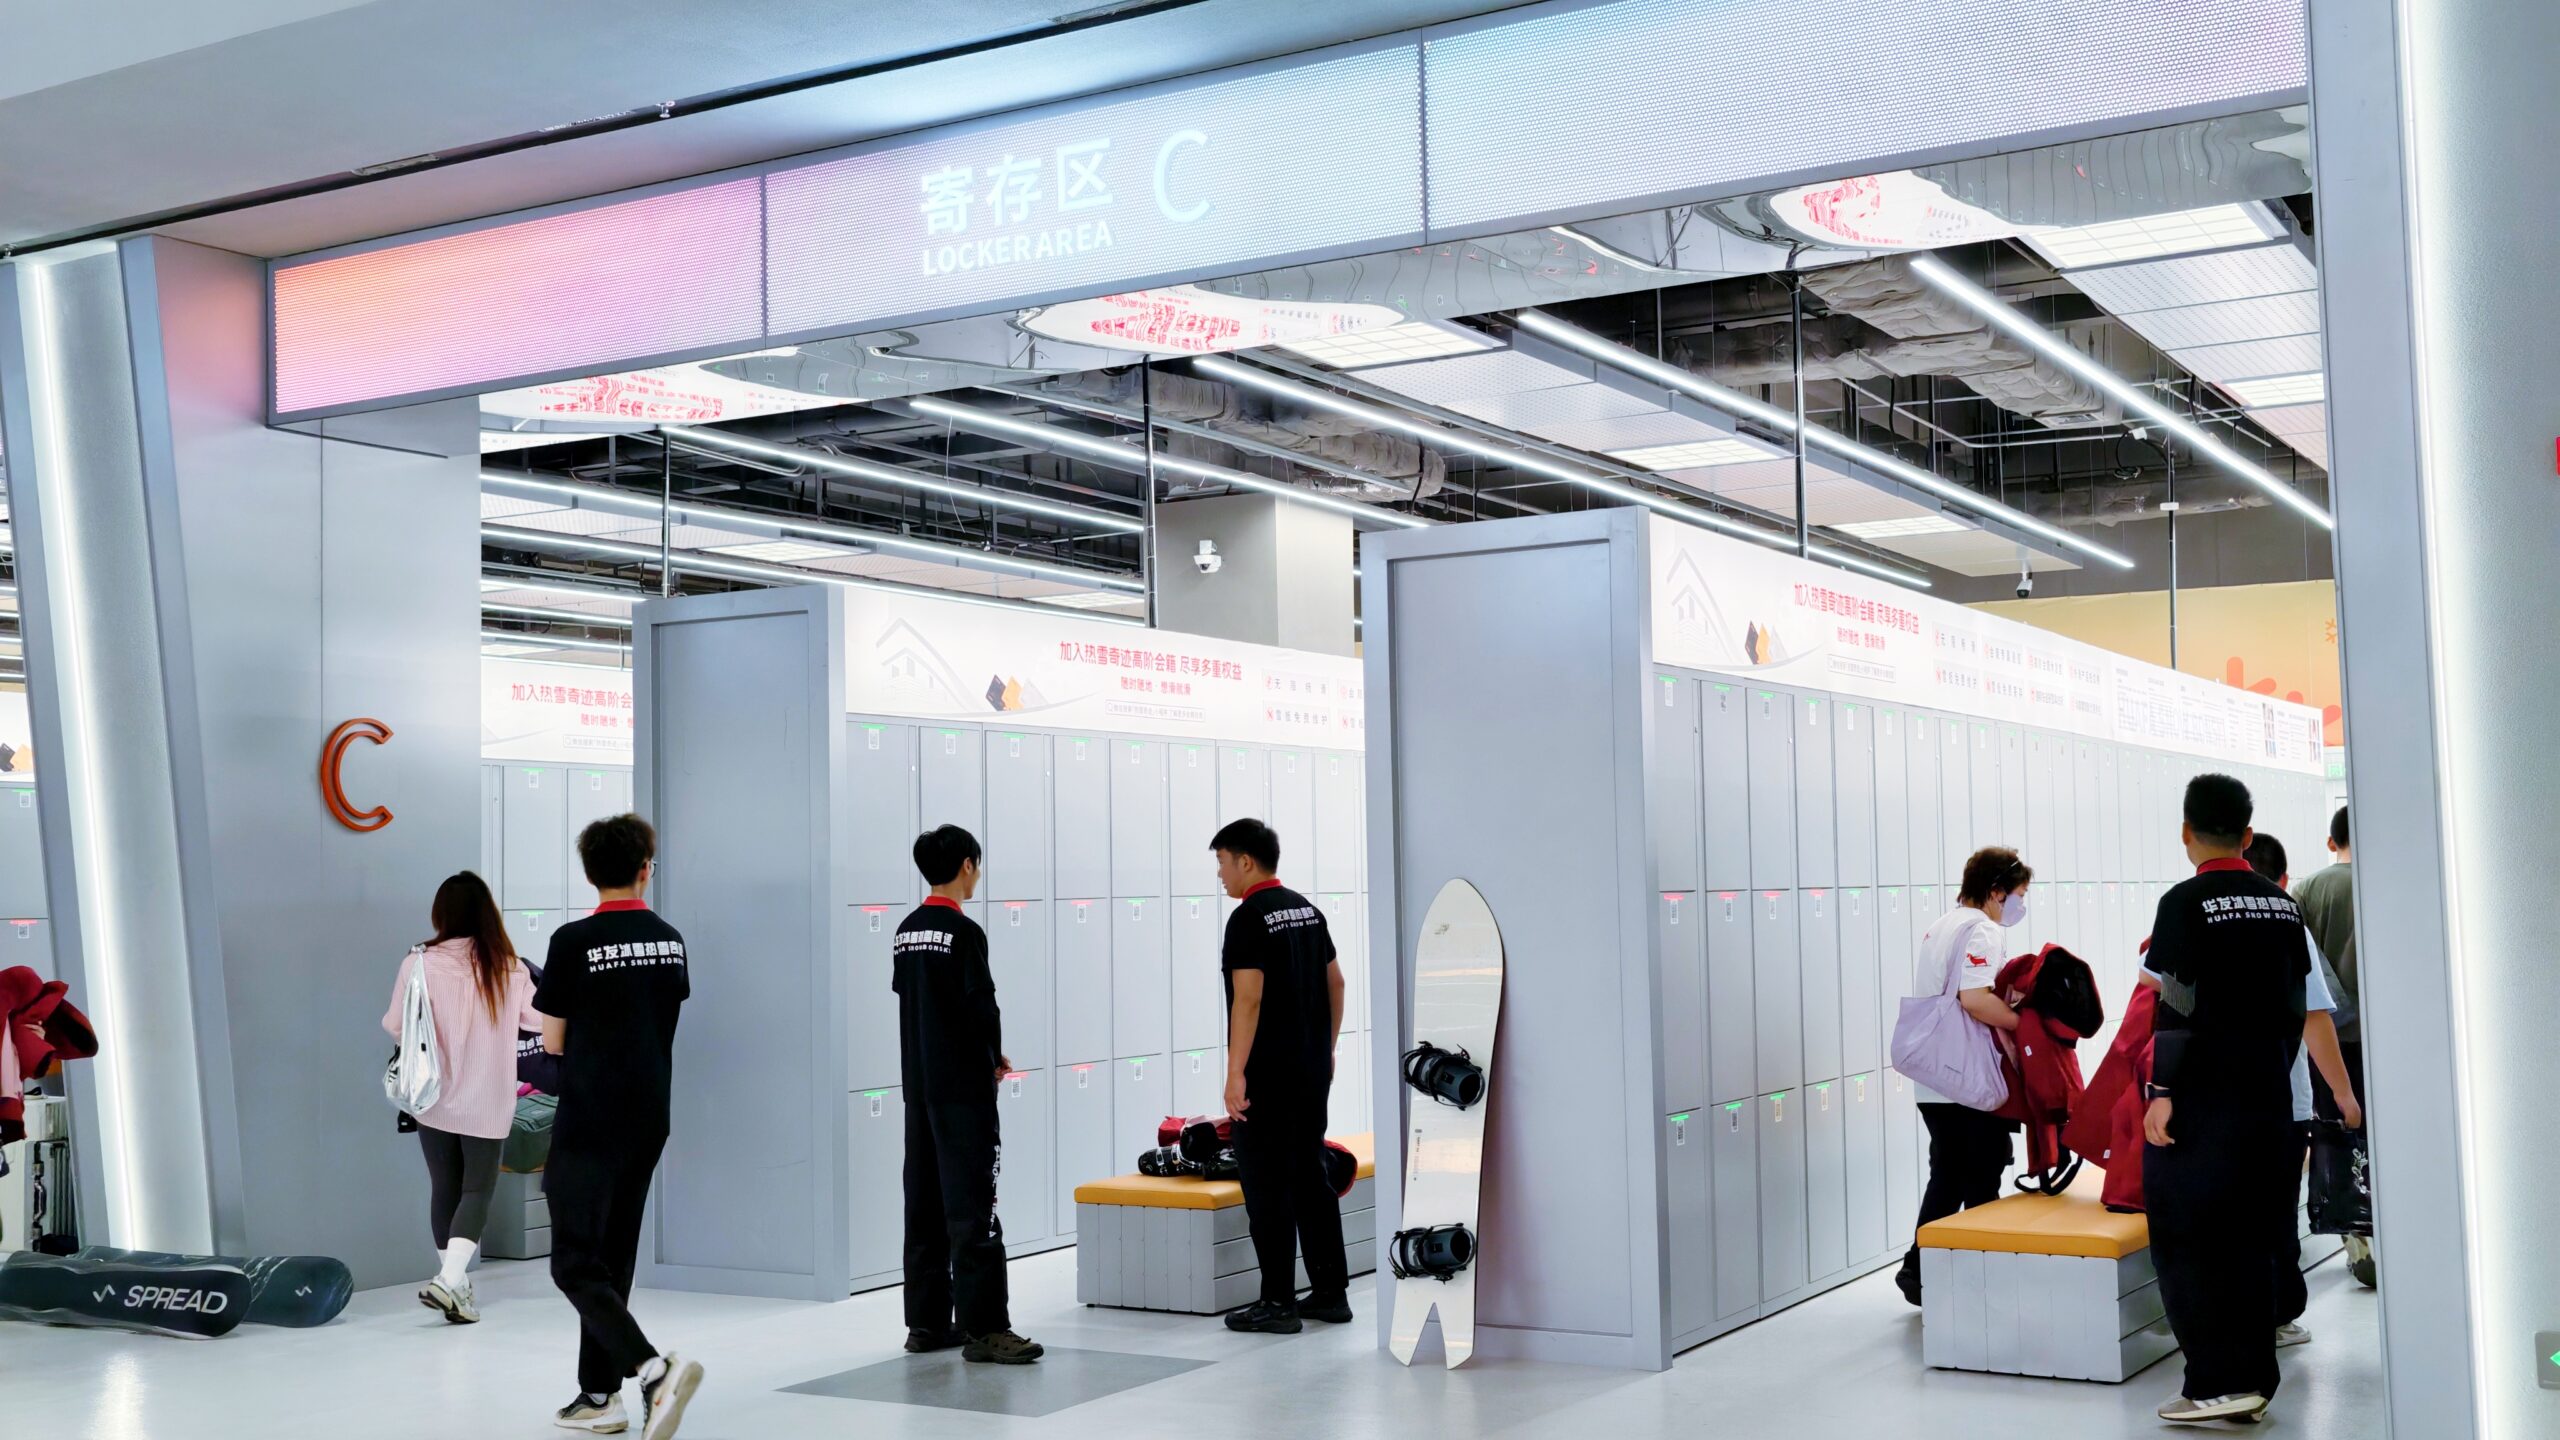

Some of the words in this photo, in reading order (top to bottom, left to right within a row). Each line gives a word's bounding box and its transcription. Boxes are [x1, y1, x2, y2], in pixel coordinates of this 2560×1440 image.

[921, 137, 1113, 234] 寄存区
[1153, 129, 1210, 223] C
[1060, 640, 1176, 673] 加入热雪奇迹高阶会籍
[1180, 655, 1242, 680] 尽享多重权益
[321, 718, 394, 832] C
[2207, 912, 2241, 924] HUAFA
[589, 960, 626, 973] HUAFA
[630, 958, 656, 966] SNOW
[124, 1285, 227, 1315] SPREAD
